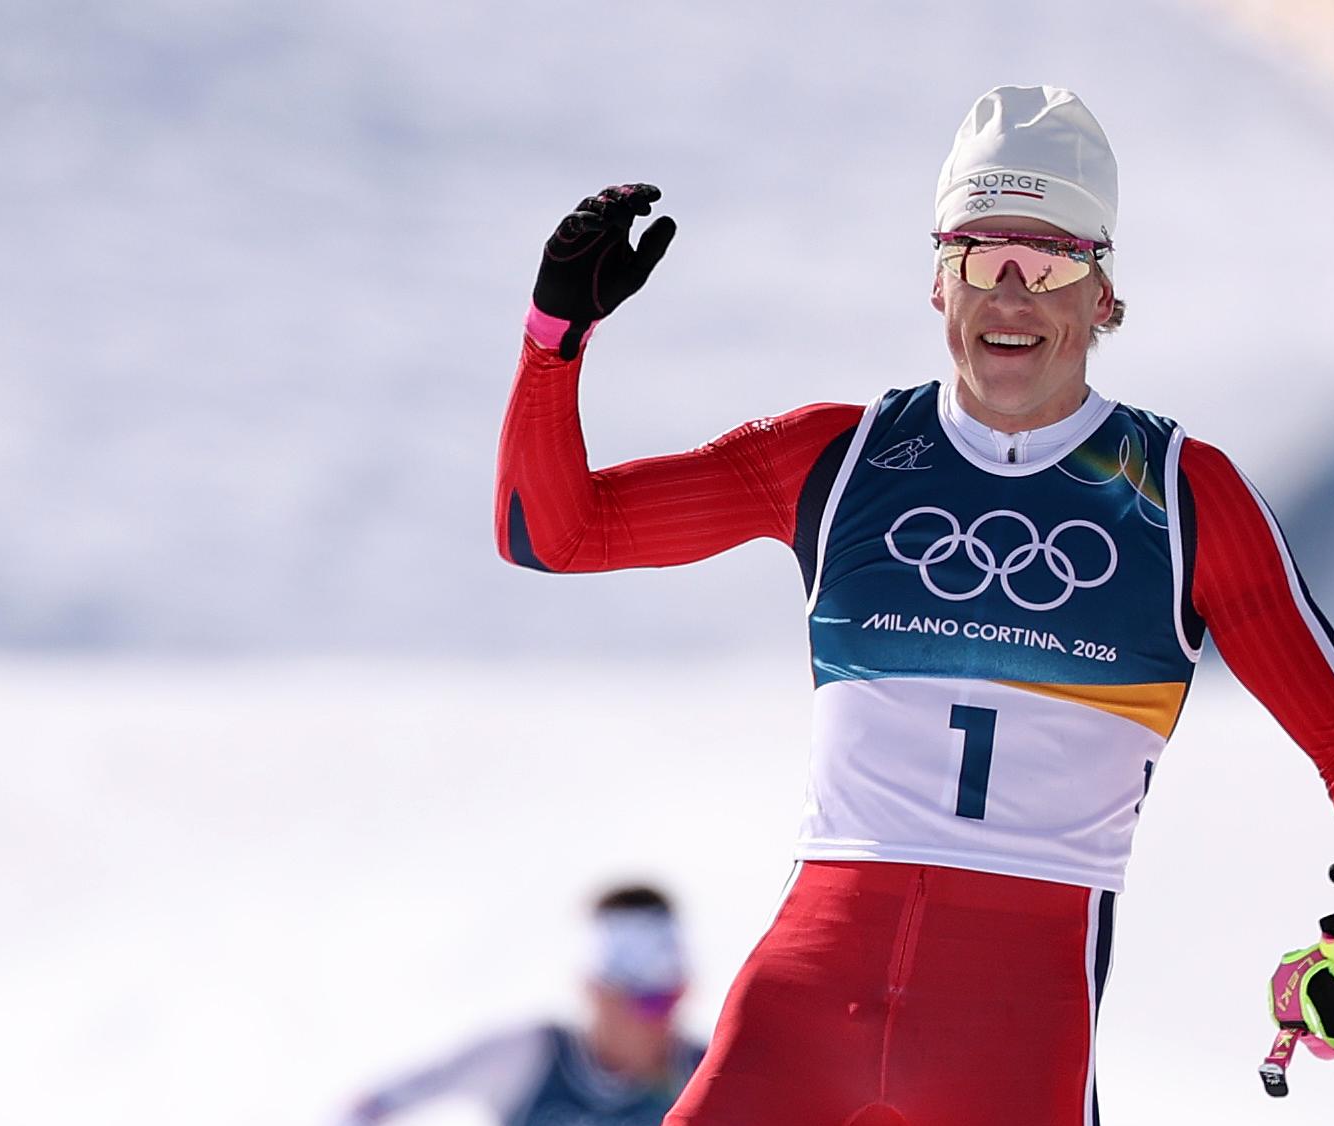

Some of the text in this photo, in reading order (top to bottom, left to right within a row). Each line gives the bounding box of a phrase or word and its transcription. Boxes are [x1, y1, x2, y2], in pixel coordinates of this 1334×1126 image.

[968, 174, 1048, 193] NORGE
[861, 613, 1117, 662] MILANO CORTINA 2026
[949, 704, 997, 820] 1
